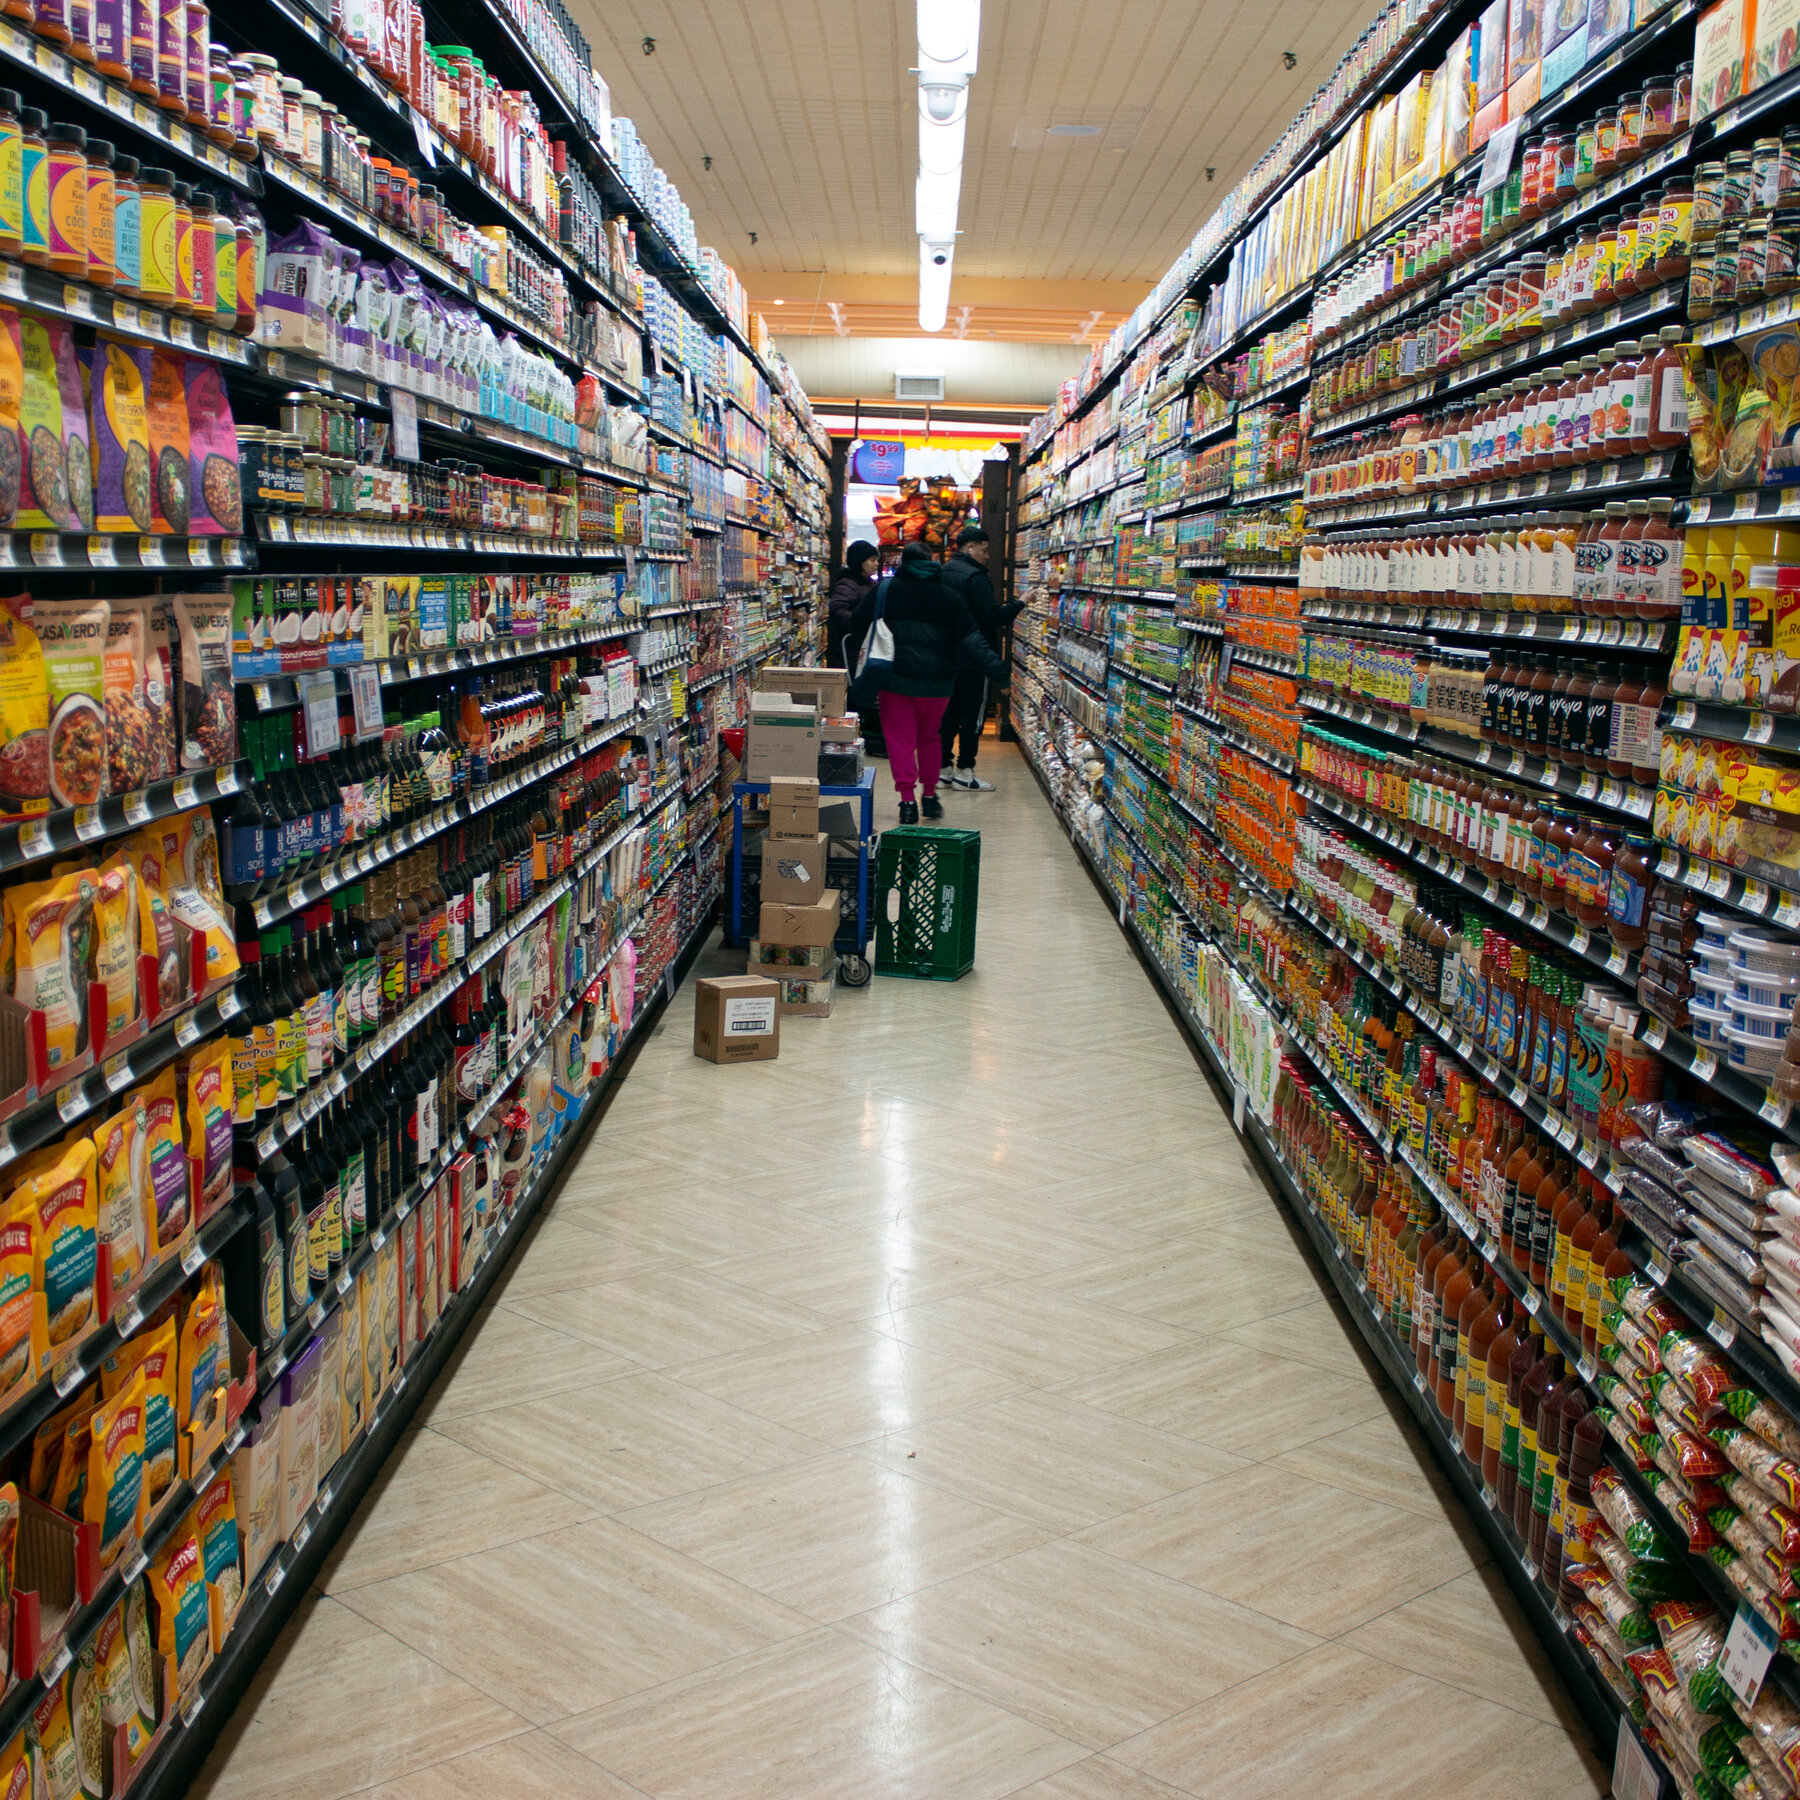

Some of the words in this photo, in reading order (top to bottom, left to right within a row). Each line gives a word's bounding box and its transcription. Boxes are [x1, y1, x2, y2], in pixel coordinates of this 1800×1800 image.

[5, 1230, 27, 1247] BITE
[54, 1229, 82, 1253] ORGANIC
[107, 1423, 122, 1453] TASTY
[121, 1413, 138, 1433] BITE
[116, 1454, 136, 1482] ORGANIC
[166, 1554, 187, 1584] TASTY
